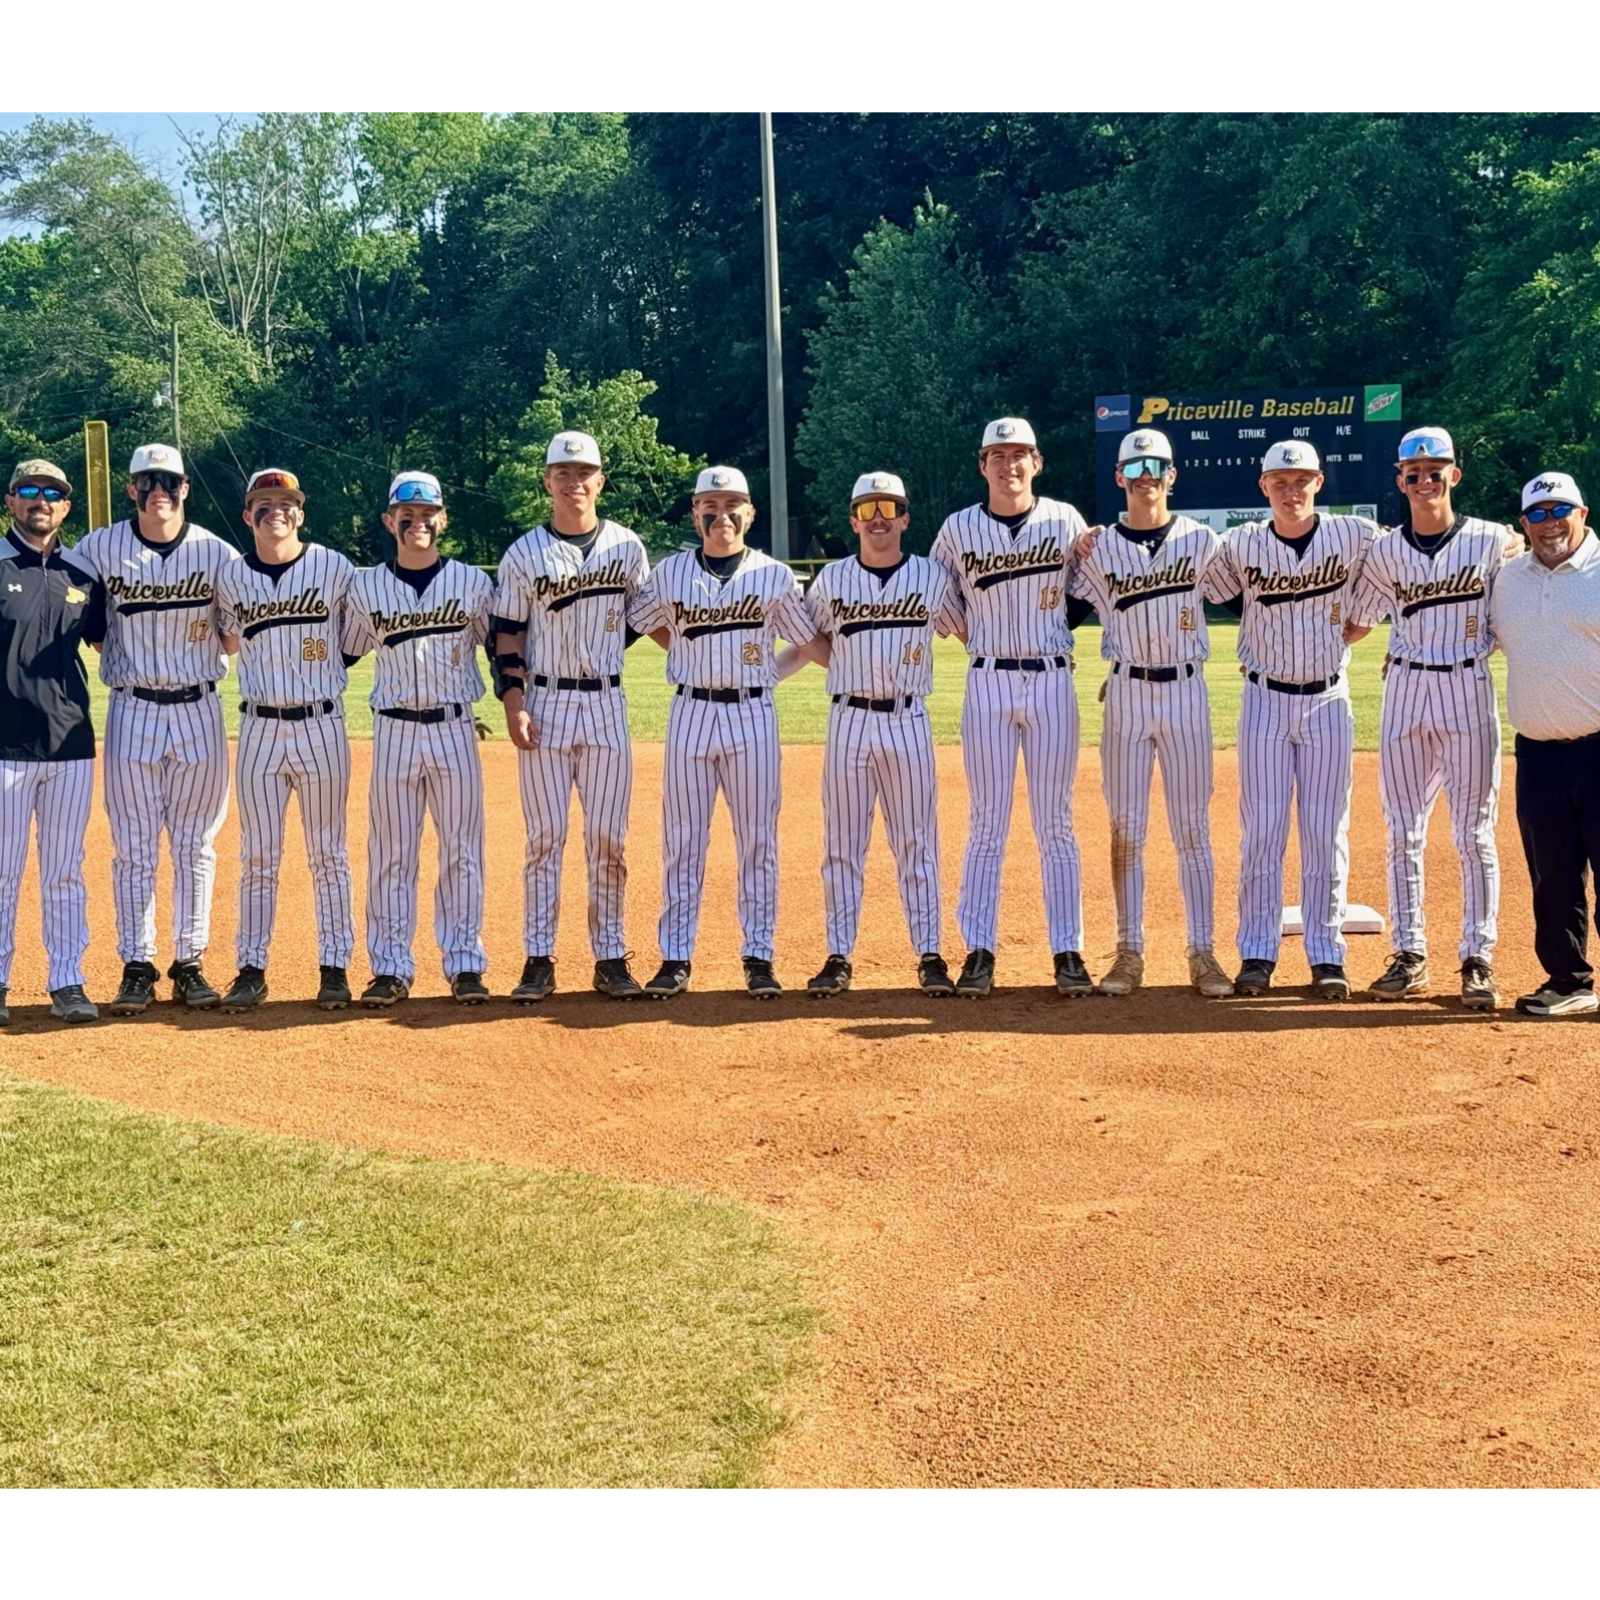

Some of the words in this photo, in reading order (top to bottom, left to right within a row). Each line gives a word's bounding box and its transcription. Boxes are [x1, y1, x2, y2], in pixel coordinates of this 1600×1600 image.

[1137, 397, 1255, 423] Priceville
[1261, 396, 1355, 418] Baseball
[1190, 430, 1211, 441] BALL
[1238, 428, 1267, 439] STRIKE
[1292, 426, 1311, 438] OUT
[1335, 425, 1352, 436] H/E
[1194, 459, 1199, 467] 2
[1203, 458, 1209, 467] 3
[1216, 458, 1222, 466] 4
[1226, 457, 1232, 466] 5
[1236, 457, 1241, 466] 6
[1326, 454, 1342, 463] HITS
[1348, 453, 1363, 462] ERR
[1530, 479, 1563, 494] Dogs
[962, 537, 1065, 577] Priceville
[107, 571, 214, 601] Priceville
[534, 559, 627, 599] Priceville
[1104, 556, 1196, 597] Priceville
[1244, 554, 1350, 594] Priceville
[1393, 565, 1487, 603] Priceville
[233, 587, 328, 624] Priceville
[672, 594, 765, 626] Priceville
[830, 592, 930, 621] Priceville
[1039, 586, 1060, 610] 13
[370, 598, 470, 631] Priceville
[1466, 615, 1478, 637] 2
[188, 619, 209, 643] 17
[303, 637, 328, 662] 26
[902, 641, 924, 665] 14
